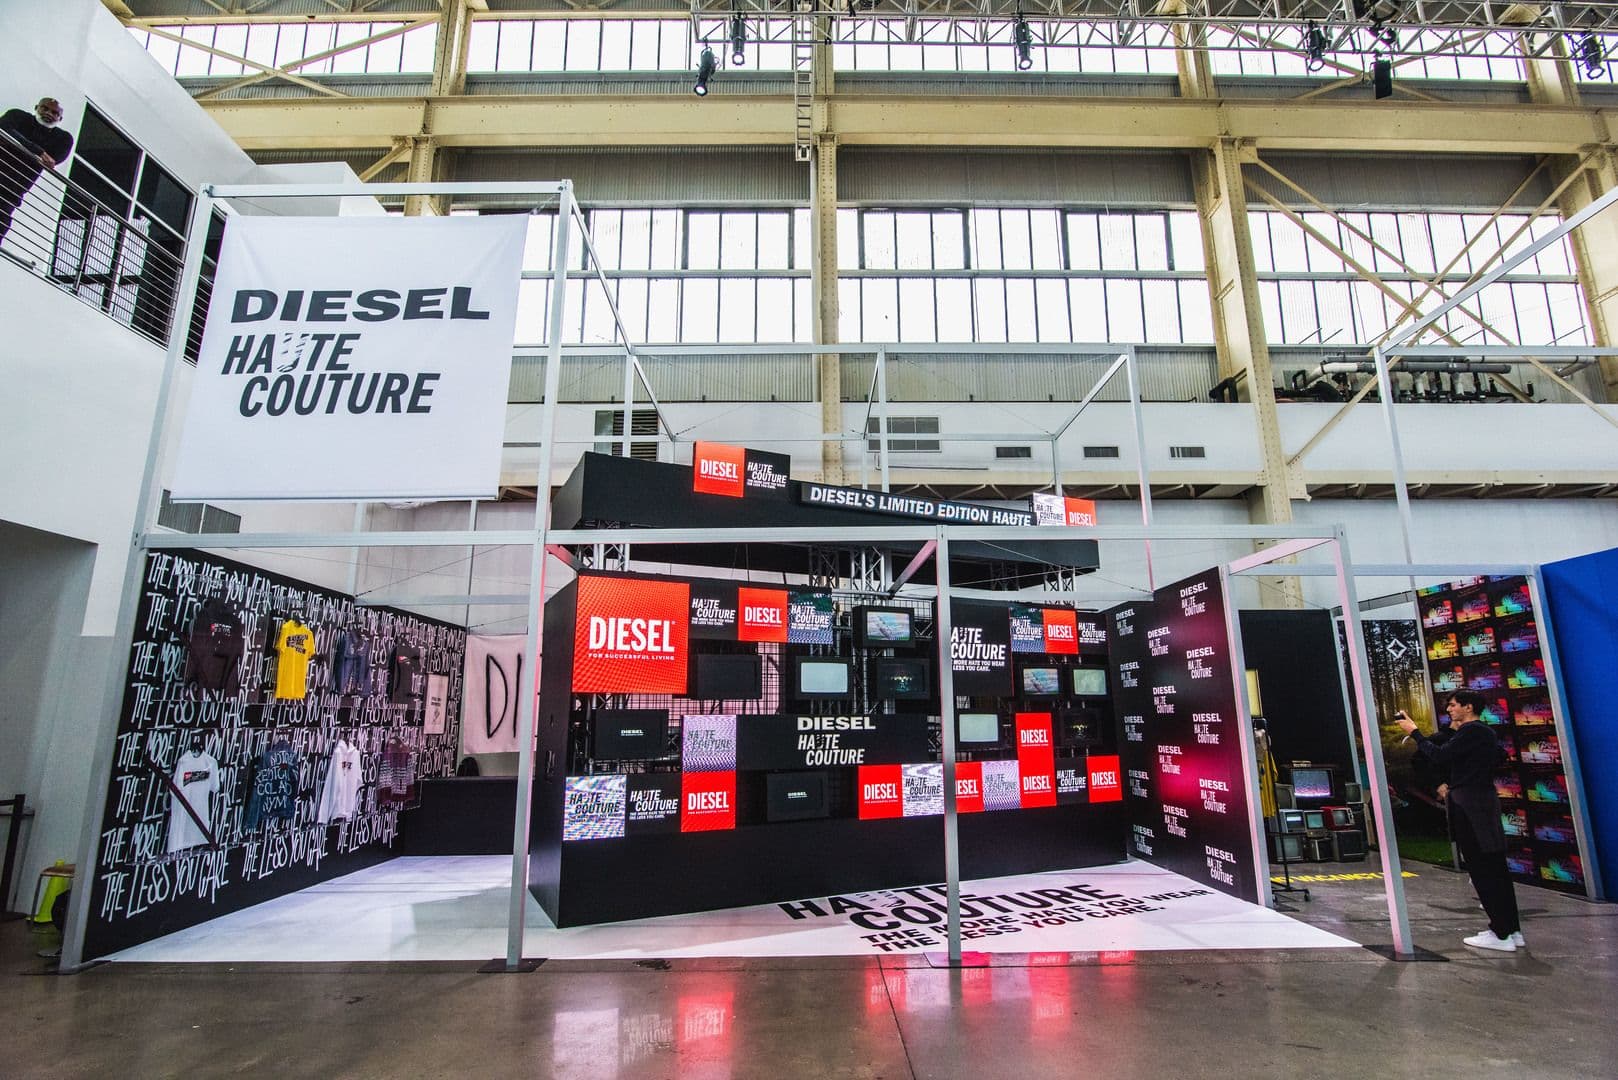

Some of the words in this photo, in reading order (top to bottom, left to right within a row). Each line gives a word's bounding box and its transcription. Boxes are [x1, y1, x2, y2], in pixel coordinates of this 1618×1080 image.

[231, 287, 490, 323] DIESEL
[222, 333, 361, 375] HAUTE
[240, 373, 440, 417] COUTURE
[701, 459, 738, 478] DIESEL
[752, 471, 787, 484] COUTURE
[811, 487, 875, 508] DIESEL'S
[879, 492, 934, 516] LIMITED
[938, 504, 989, 522] EDITION
[992, 512, 1031, 526] HAUTE
[1069, 512, 1093, 527] DIESEL
[147, 552, 172, 590] THE
[1180, 582, 1208, 597] DIESEL
[1182, 596, 1196, 609] HATE
[1185, 602, 1205, 616] COUTURE
[146, 592, 174, 639] THE
[697, 608, 736, 619] COUTURE
[745, 607, 782, 623] DIESEL
[796, 614, 829, 624] COUTURE
[1116, 609, 1135, 620] DIESEL
[1117, 619, 1127, 629] HATE
[589, 616, 675, 652] DIESEL
[951, 627, 982, 643] AUTE
[1016, 627, 1043, 635] COUTURE
[1048, 625, 1073, 638] DIESEL
[1148, 626, 1170, 639] DIESEL
[1149, 638, 1161, 649] HATE
[951, 643, 1006, 660] COUTURE
[1152, 645, 1168, 656] COUTURE
[1187, 647, 1214, 659] DIESEL
[132, 640, 160, 679] THE
[1188, 659, 1202, 670] HATE
[1120, 662, 1140, 671] DIESEL
[1191, 667, 1212, 679] COUTURE
[1121, 672, 1131, 680] HATE
[1153, 686, 1176, 695] DIESEL
[131, 682, 160, 730] THE
[1154, 696, 1166, 705] HATE
[1157, 704, 1174, 714] COUTURE
[798, 717, 876, 730] DIESEL
[1193, 713, 1222, 722] DIESEL
[688, 730, 716, 740] HATE
[1125, 725, 1136, 733] HATE
[1194, 724, 1209, 734] HATE
[1021, 729, 1048, 743] DIESEL
[1198, 734, 1219, 744] COUTURE
[117, 732, 144, 773] THE
[145, 730, 177, 769] MORE
[1158, 745, 1182, 755] DIESEL
[806, 750, 864, 766] COUTURE
[1160, 755, 1172, 764] HATE
[1129, 770, 1149, 780] DIESEL
[1162, 764, 1181, 774] COUTURE
[1023, 776, 1051, 791] DIESEL
[1061, 777, 1086, 786] COUTURE
[1092, 772, 1117, 785] DIESEL
[1130, 779, 1140, 787] HATE
[1200, 779, 1229, 791] DIESEL
[864, 784, 897, 800] DIESEL
[910, 786, 941, 795] COUTURE
[955, 780, 978, 795] IESEL
[116, 774, 146, 824] THE
[688, 792, 728, 810] DIESEL
[1201, 790, 1216, 801] HATE
[575, 802, 620, 814] COUTURE
[636, 799, 678, 811] COUTURE
[1163, 805, 1188, 818] DIESEL
[1204, 801, 1226, 814] COUTURE
[1165, 815, 1177, 826] HATE
[1133, 824, 1154, 837] DIESEL
[1168, 825, 1186, 837] COUTURE
[102, 827, 130, 869] THE
[129, 822, 163, 861] MORE
[1135, 834, 1145, 845] HATE
[1206, 845, 1236, 863] DIESEL
[1207, 858, 1222, 871] HATE
[101, 872, 131, 922] THE
[126, 862, 171, 919] LESS
[172, 855, 202, 903] YOU
[198, 849, 230, 905] CARE
[242, 842, 261, 882] THE
[258, 835, 289, 880] LESS
[289, 831, 310, 869] YOU
[306, 824, 329, 872] CARE
[1211, 870, 1233, 886] COUTURE
[850, 884, 1125, 930] COUTURE
[861, 929, 926, 943] THE
[1020, 905, 1092, 920] HATE
[1091, 897, 1145, 909] YOU
[1143, 889, 1215, 902] WEAR
[871, 937, 940, 952] THE
[1022, 914, 1084, 928] YOU
[1086, 904, 1166, 919] CARE.
